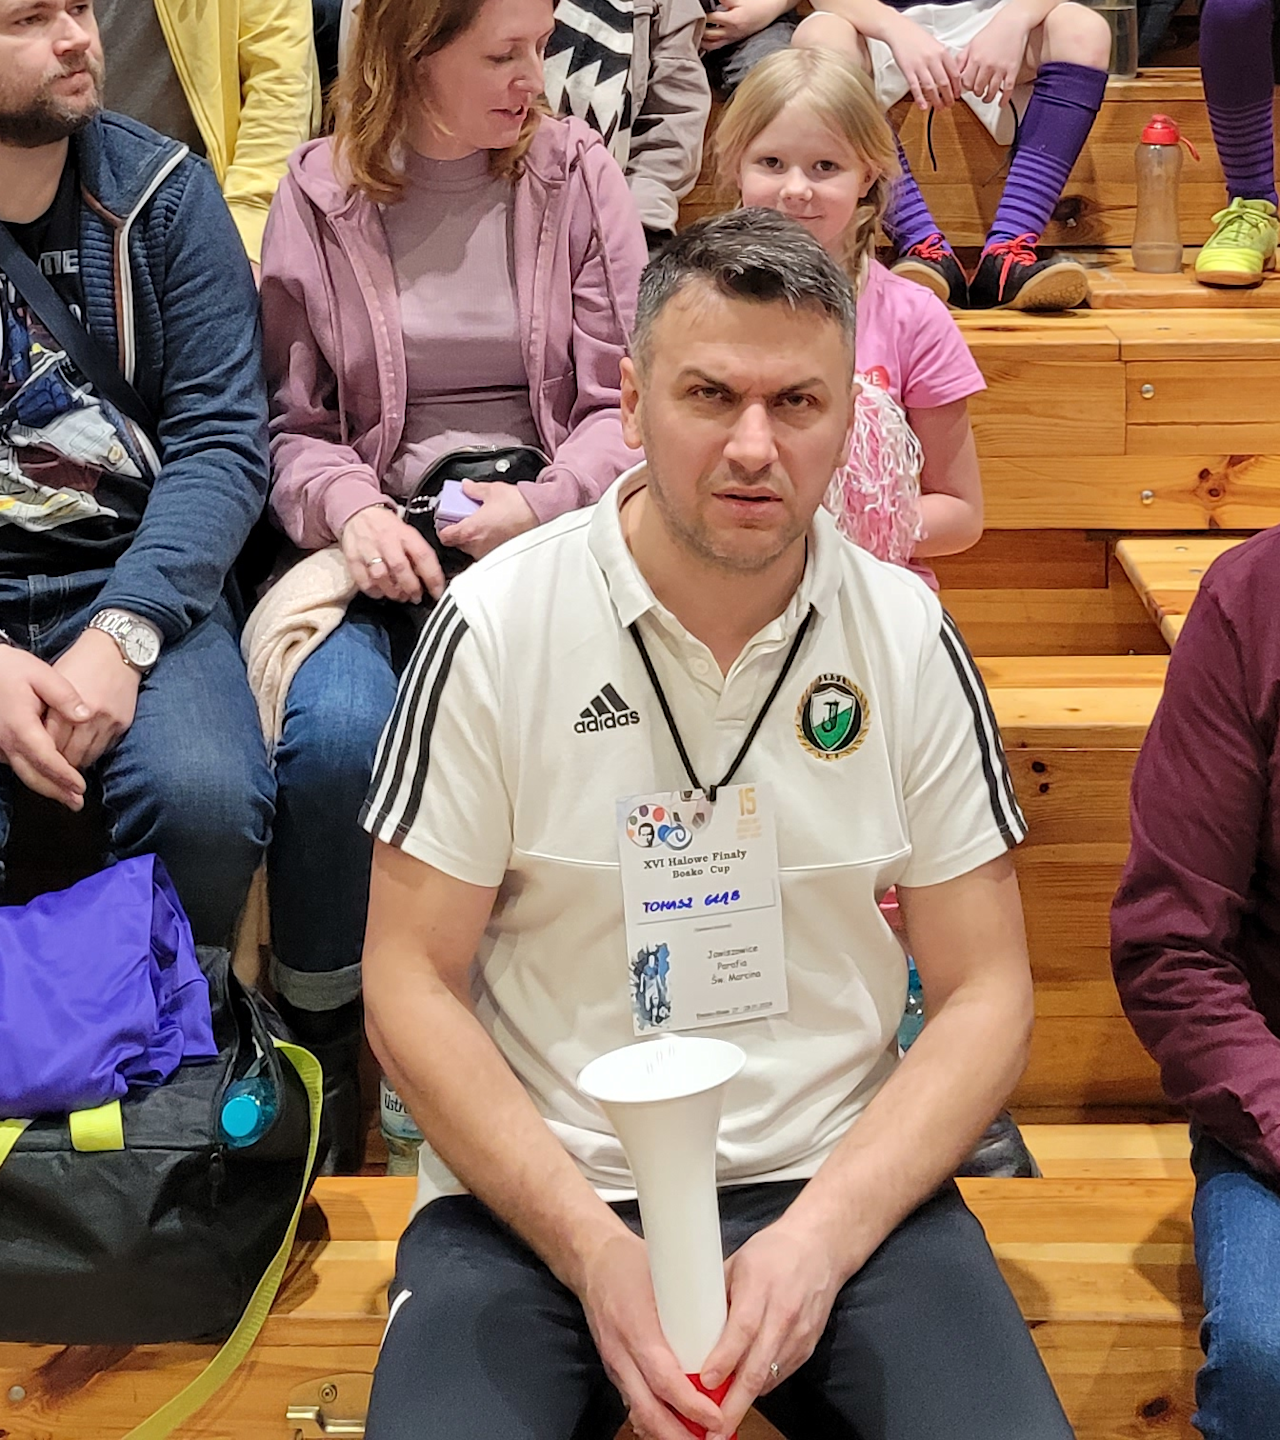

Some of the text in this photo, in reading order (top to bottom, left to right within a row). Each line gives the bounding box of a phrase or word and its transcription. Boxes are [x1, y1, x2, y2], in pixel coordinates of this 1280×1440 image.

[574, 711, 640, 733] adidas
[738, 787, 757, 817] 15
[644, 858, 666, 870] XVI
[668, 853, 709, 867] Halowe
[710, 864, 731, 875] Cup
